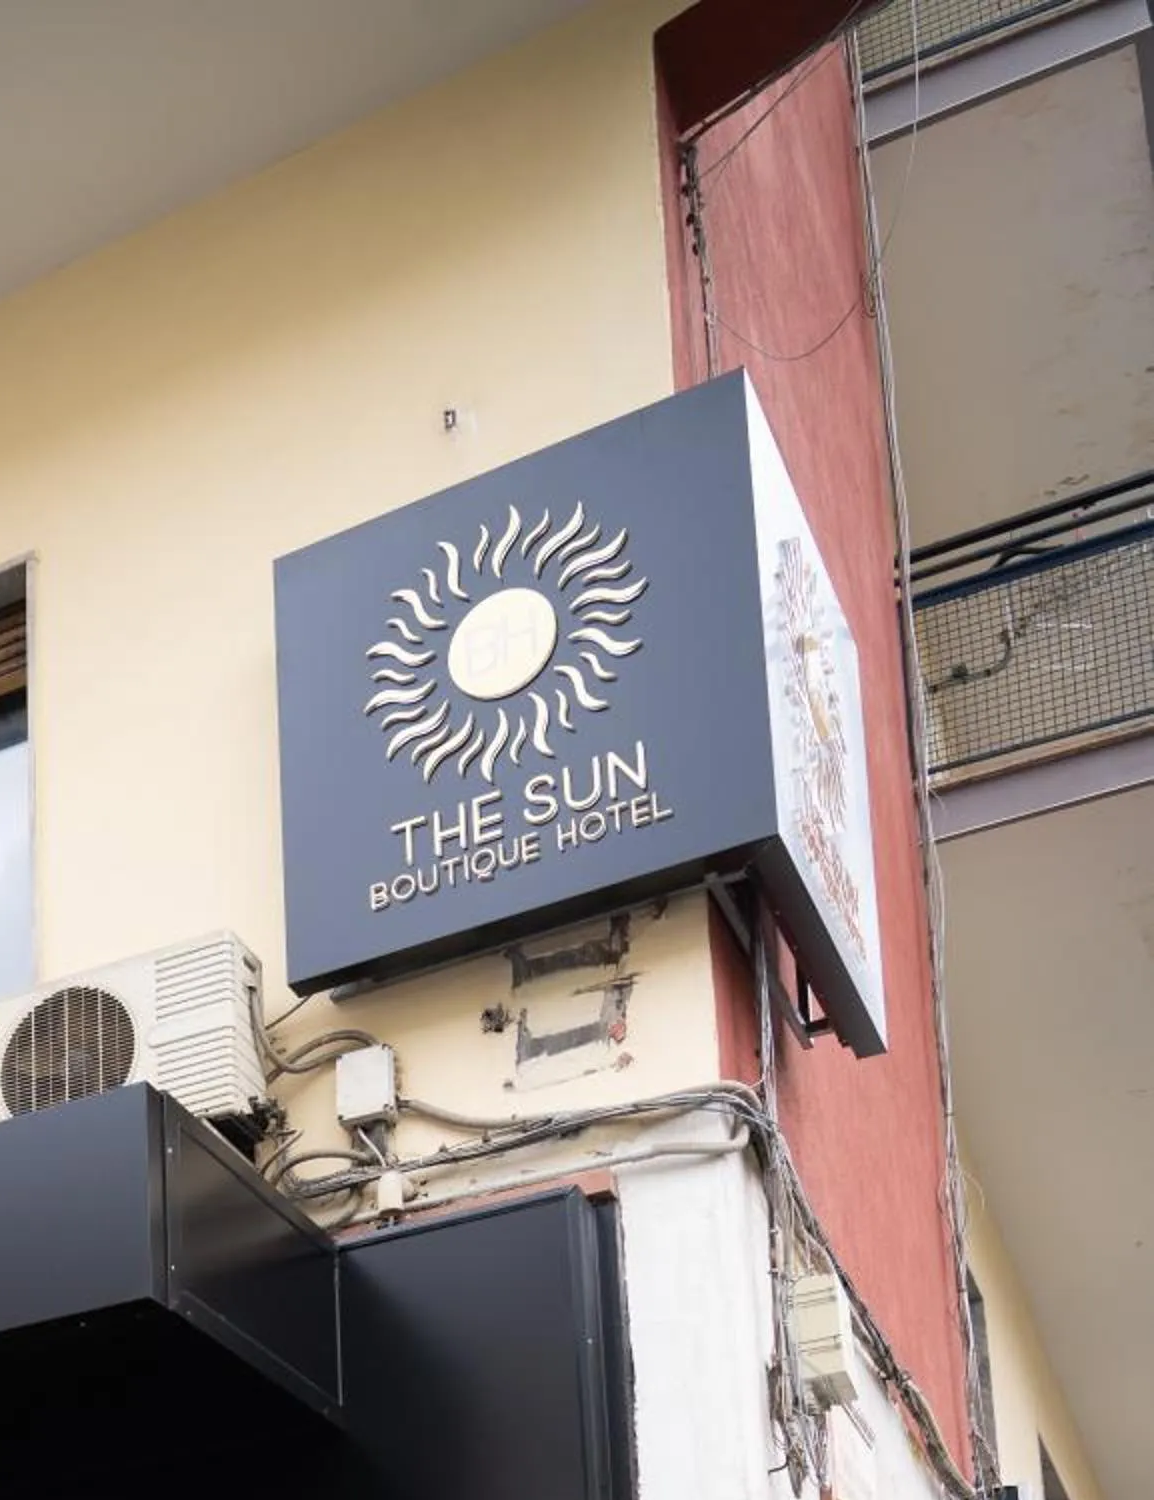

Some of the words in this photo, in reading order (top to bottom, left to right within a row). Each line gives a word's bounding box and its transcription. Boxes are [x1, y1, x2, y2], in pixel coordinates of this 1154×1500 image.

[370, 837, 542, 912] BOUTIQUE
[558, 791, 673, 853] HOTEL
[390, 789, 503, 867] THE
[523, 740, 649, 826] SUN
